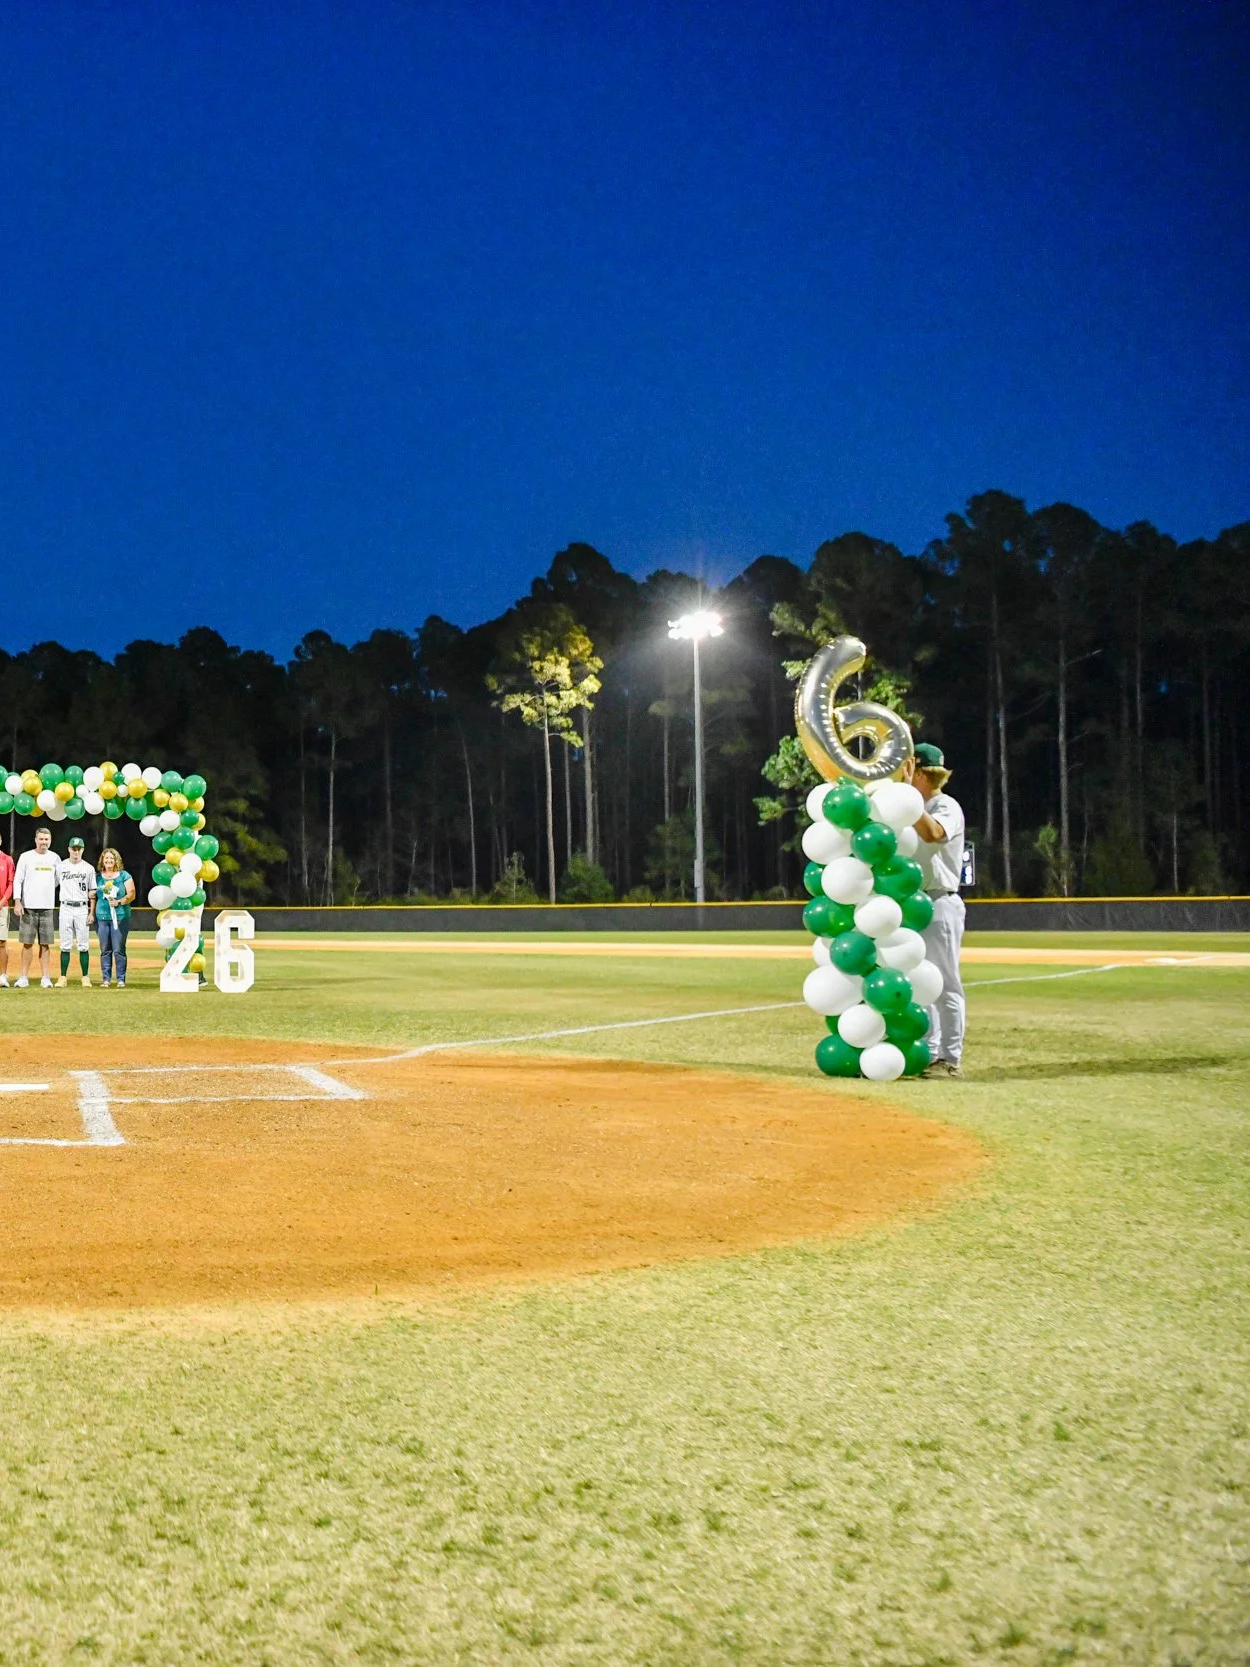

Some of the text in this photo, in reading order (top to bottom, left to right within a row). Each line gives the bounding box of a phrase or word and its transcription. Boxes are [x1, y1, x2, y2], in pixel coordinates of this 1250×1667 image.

[795, 635, 914, 784] 6
[61, 871, 87, 881] Fleming
[159, 910, 255, 992] 26
